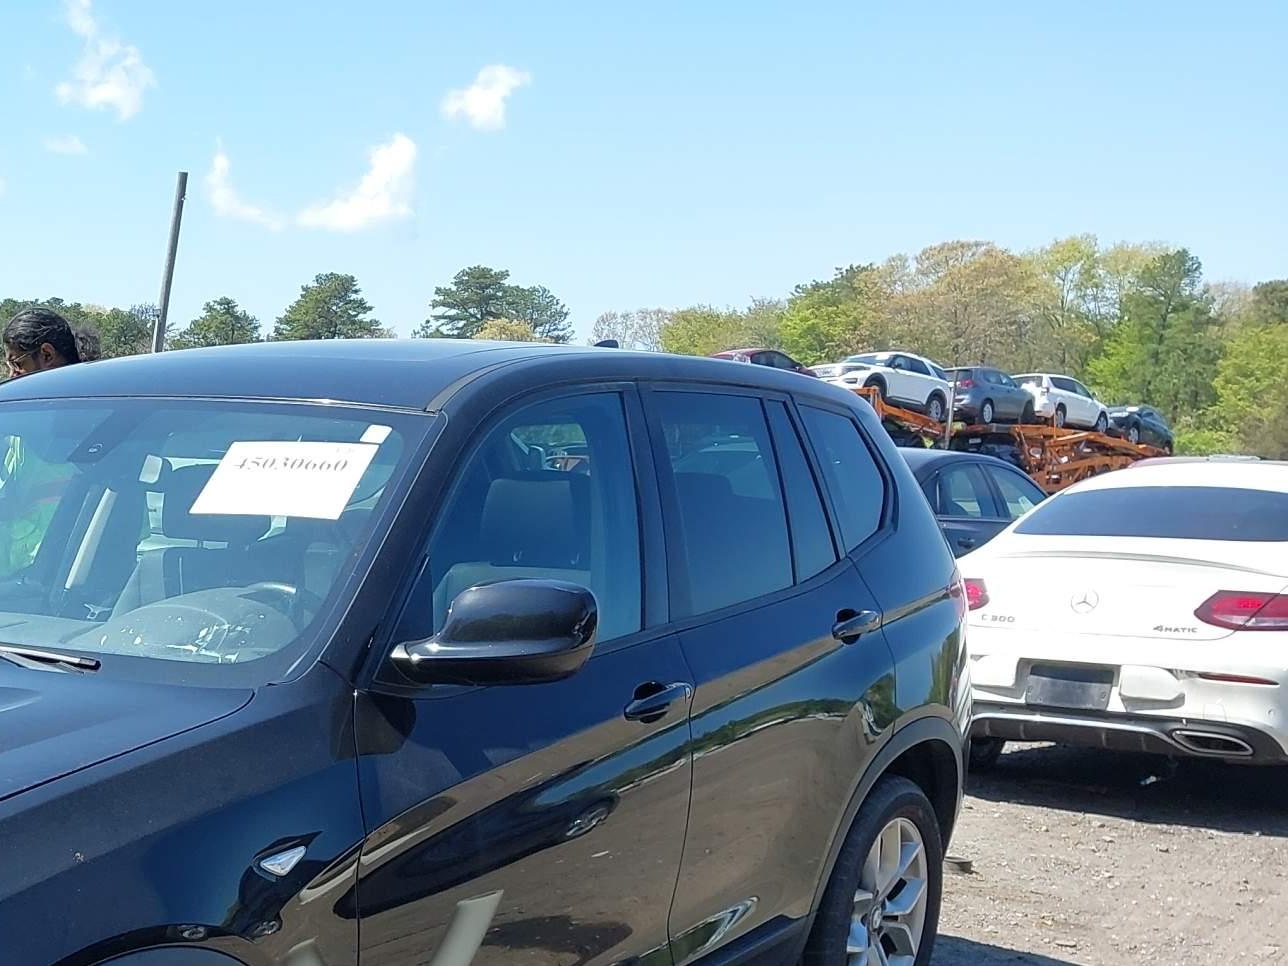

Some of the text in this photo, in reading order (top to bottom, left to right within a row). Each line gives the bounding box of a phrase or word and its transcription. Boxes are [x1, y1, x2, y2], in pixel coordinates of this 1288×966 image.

[234, 456, 348, 471] 45030660
[991, 615, 1016, 623] 300
[1153, 624, 1198, 633] 4MATIC
